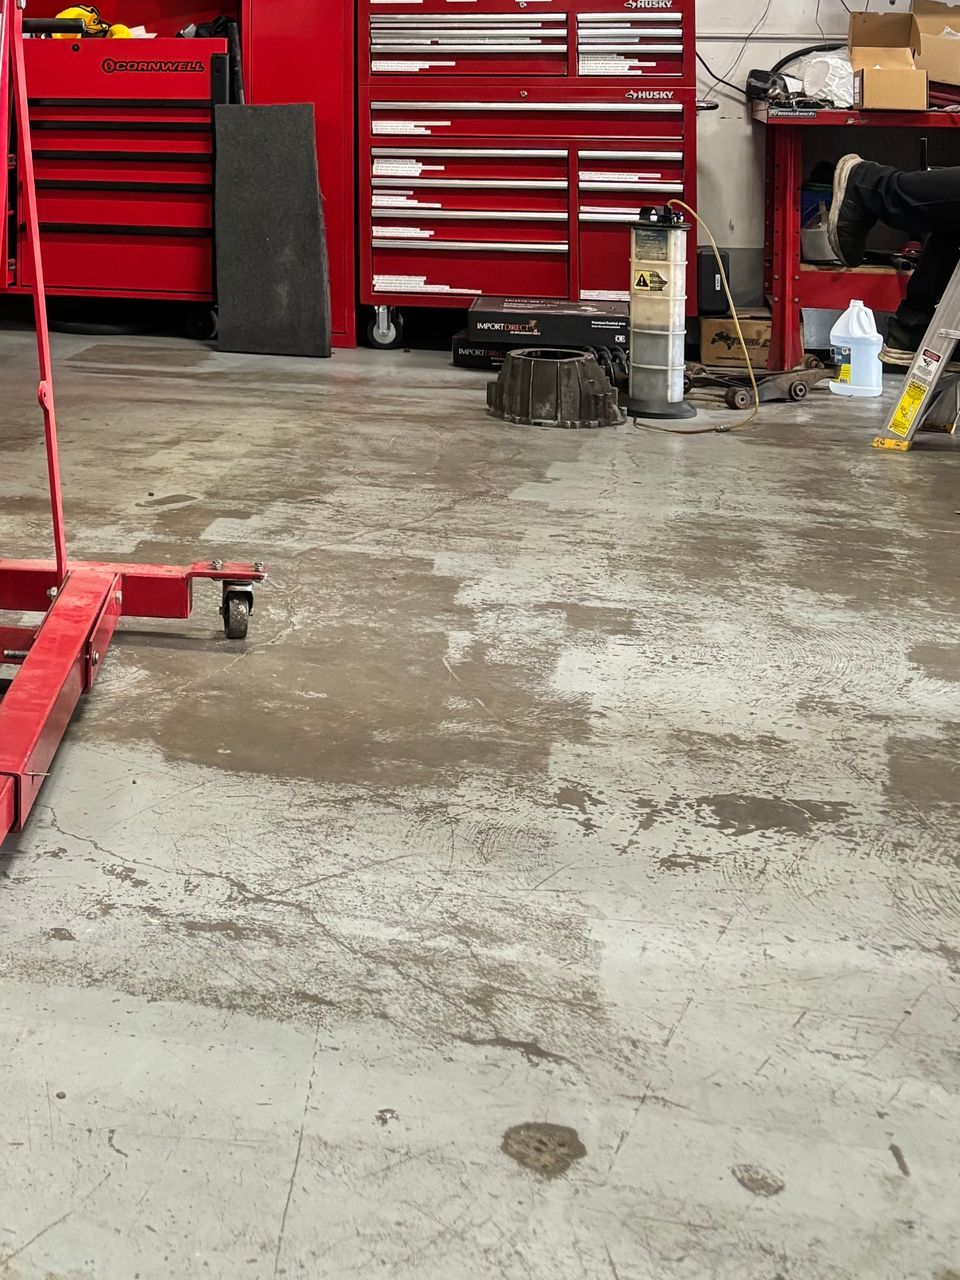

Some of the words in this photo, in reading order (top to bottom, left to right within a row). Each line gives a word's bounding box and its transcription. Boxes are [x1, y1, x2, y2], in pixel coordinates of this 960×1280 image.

[637, 0, 672, 8] HUSKY
[115, 61, 205, 72] CORNWELL
[638, 91, 673, 99] HUSKY
